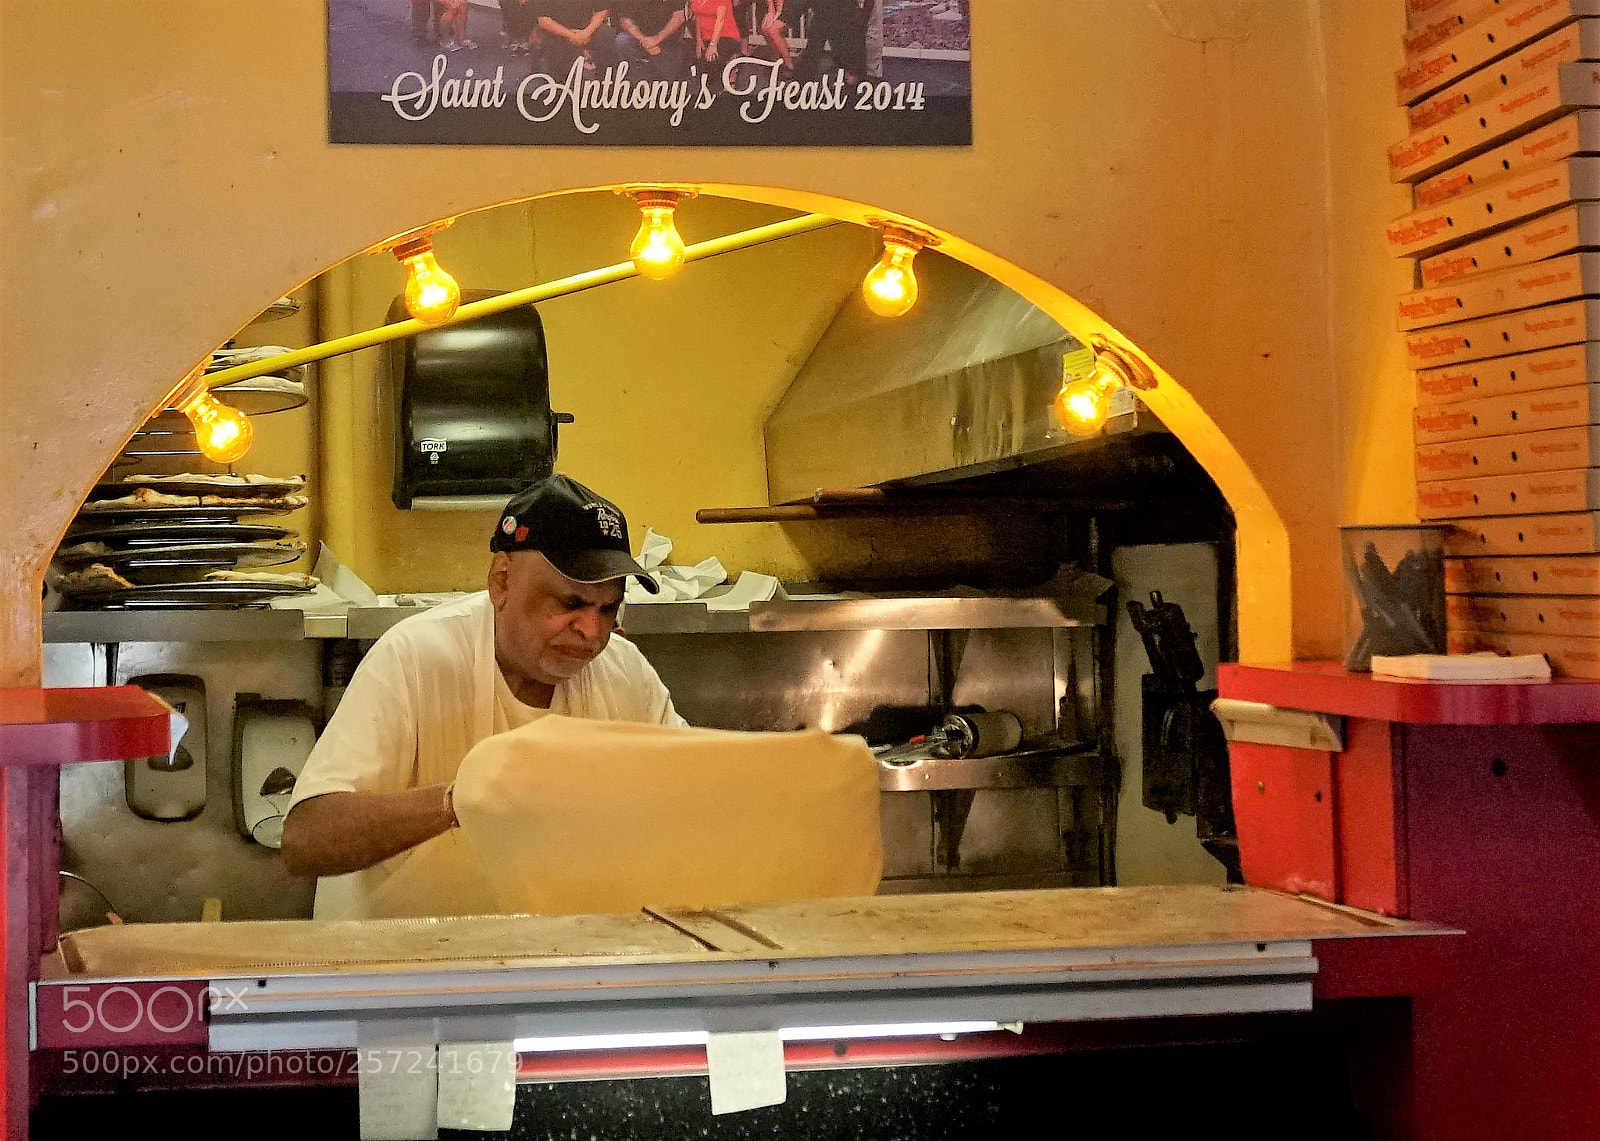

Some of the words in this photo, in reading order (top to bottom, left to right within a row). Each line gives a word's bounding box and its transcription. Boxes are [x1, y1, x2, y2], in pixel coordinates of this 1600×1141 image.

[381, 53, 506, 121] Saint
[516, 55, 716, 134] Anthony's
[721, 56, 848, 123] Feast
[854, 81, 925, 111] 2014
